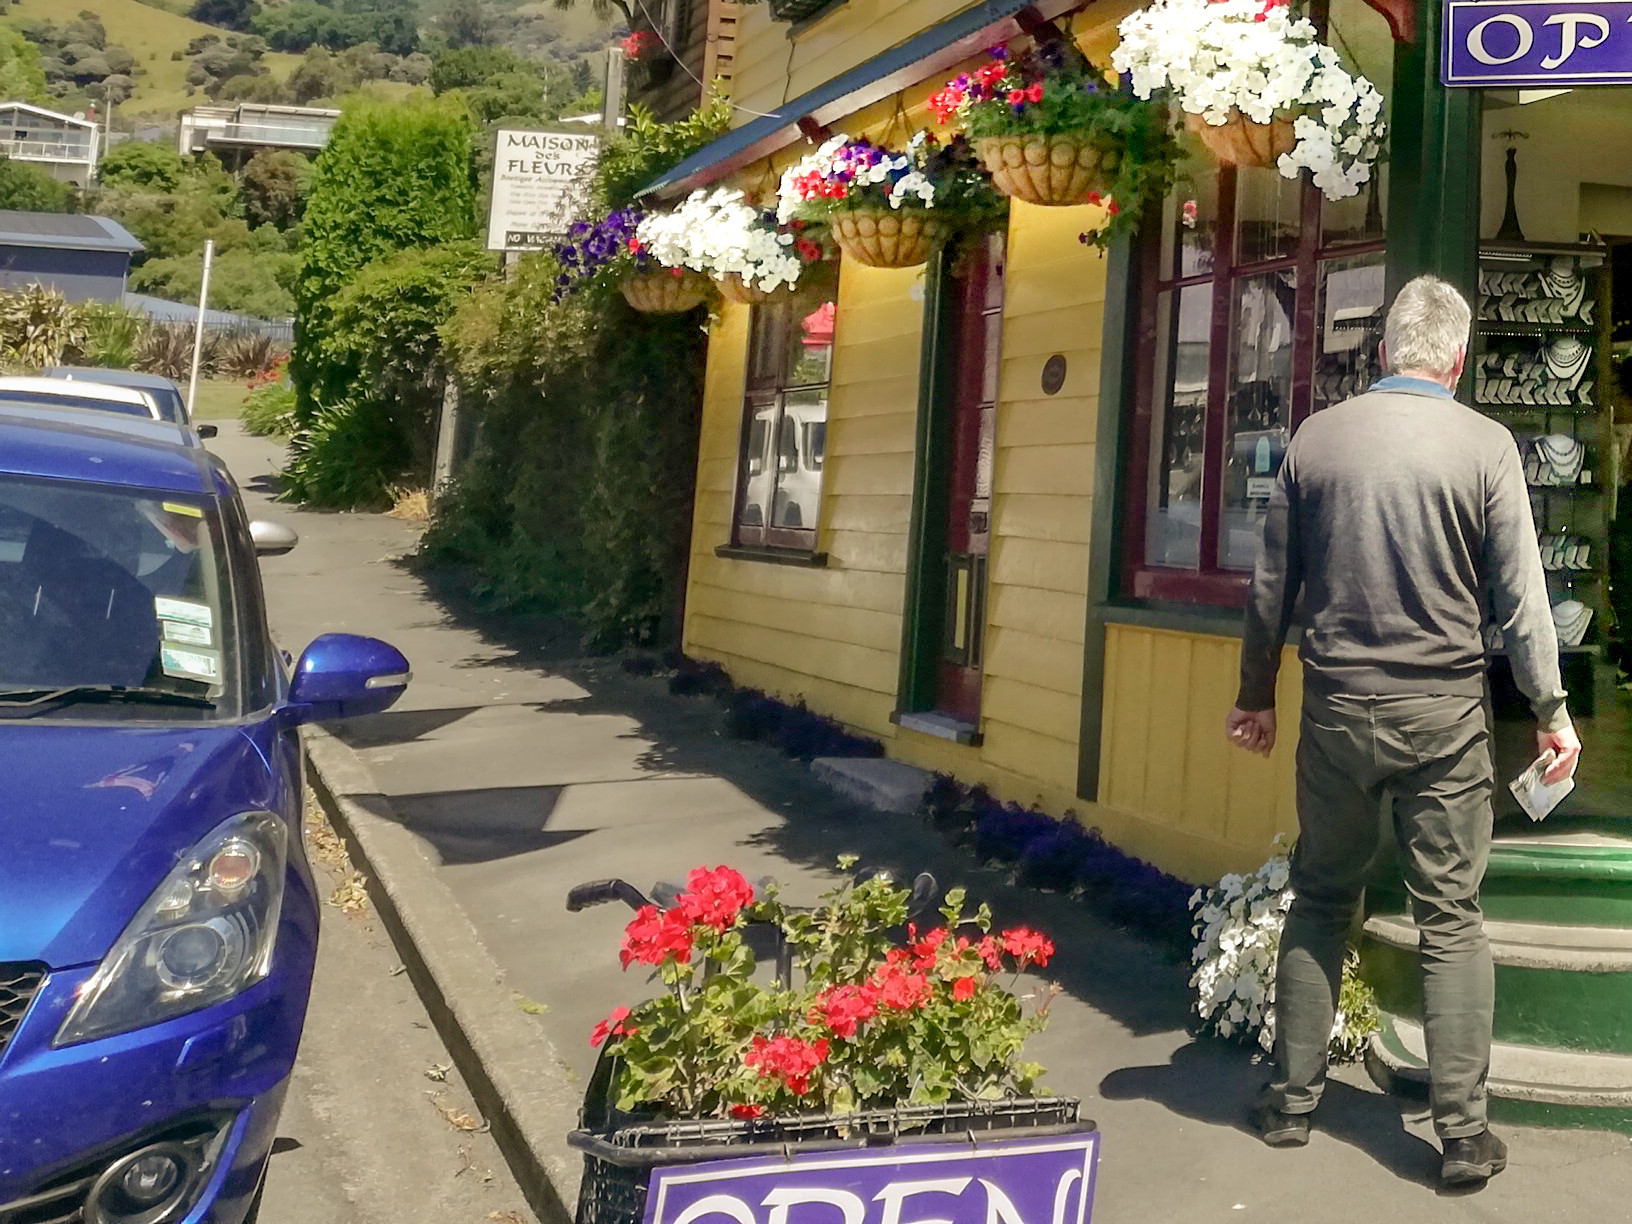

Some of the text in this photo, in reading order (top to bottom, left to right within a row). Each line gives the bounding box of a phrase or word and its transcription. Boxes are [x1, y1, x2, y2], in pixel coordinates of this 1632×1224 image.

[507, 134, 589, 151] MAISON
[535, 151, 560, 160] des
[508, 160, 587, 176] FLEURS
[508, 234, 520, 243] NO
